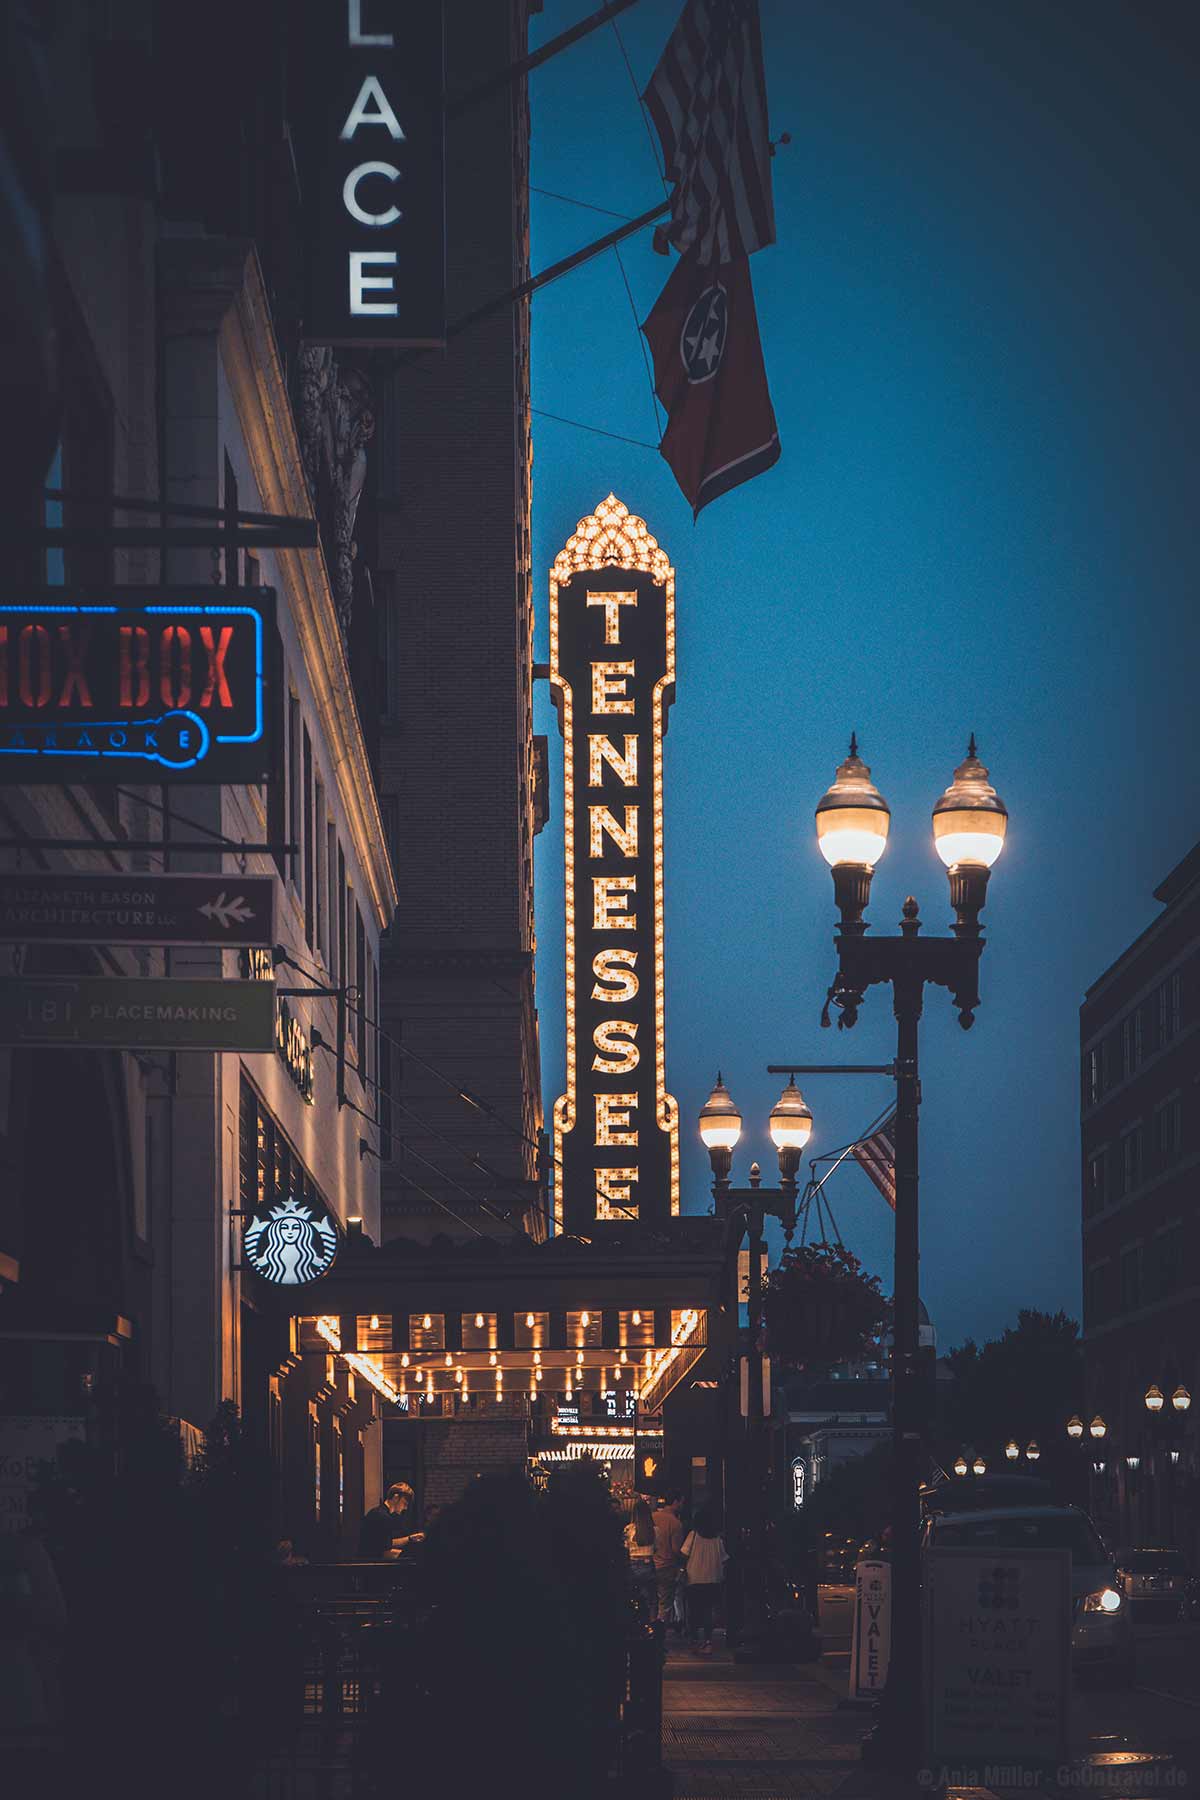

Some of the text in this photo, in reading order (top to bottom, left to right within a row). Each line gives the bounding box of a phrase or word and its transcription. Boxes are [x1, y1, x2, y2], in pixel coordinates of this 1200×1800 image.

[338, 0, 406, 317] LACE
[119, 625, 234, 708] BOX
[585, 590, 641, 1222] TENNESSEE
[89, 1004, 239, 1022] PLACEMAKING
[867, 1605, 881, 1687] VALET
[959, 1616, 1041, 1634] HYATT
[967, 1667, 1033, 1688] VALET
